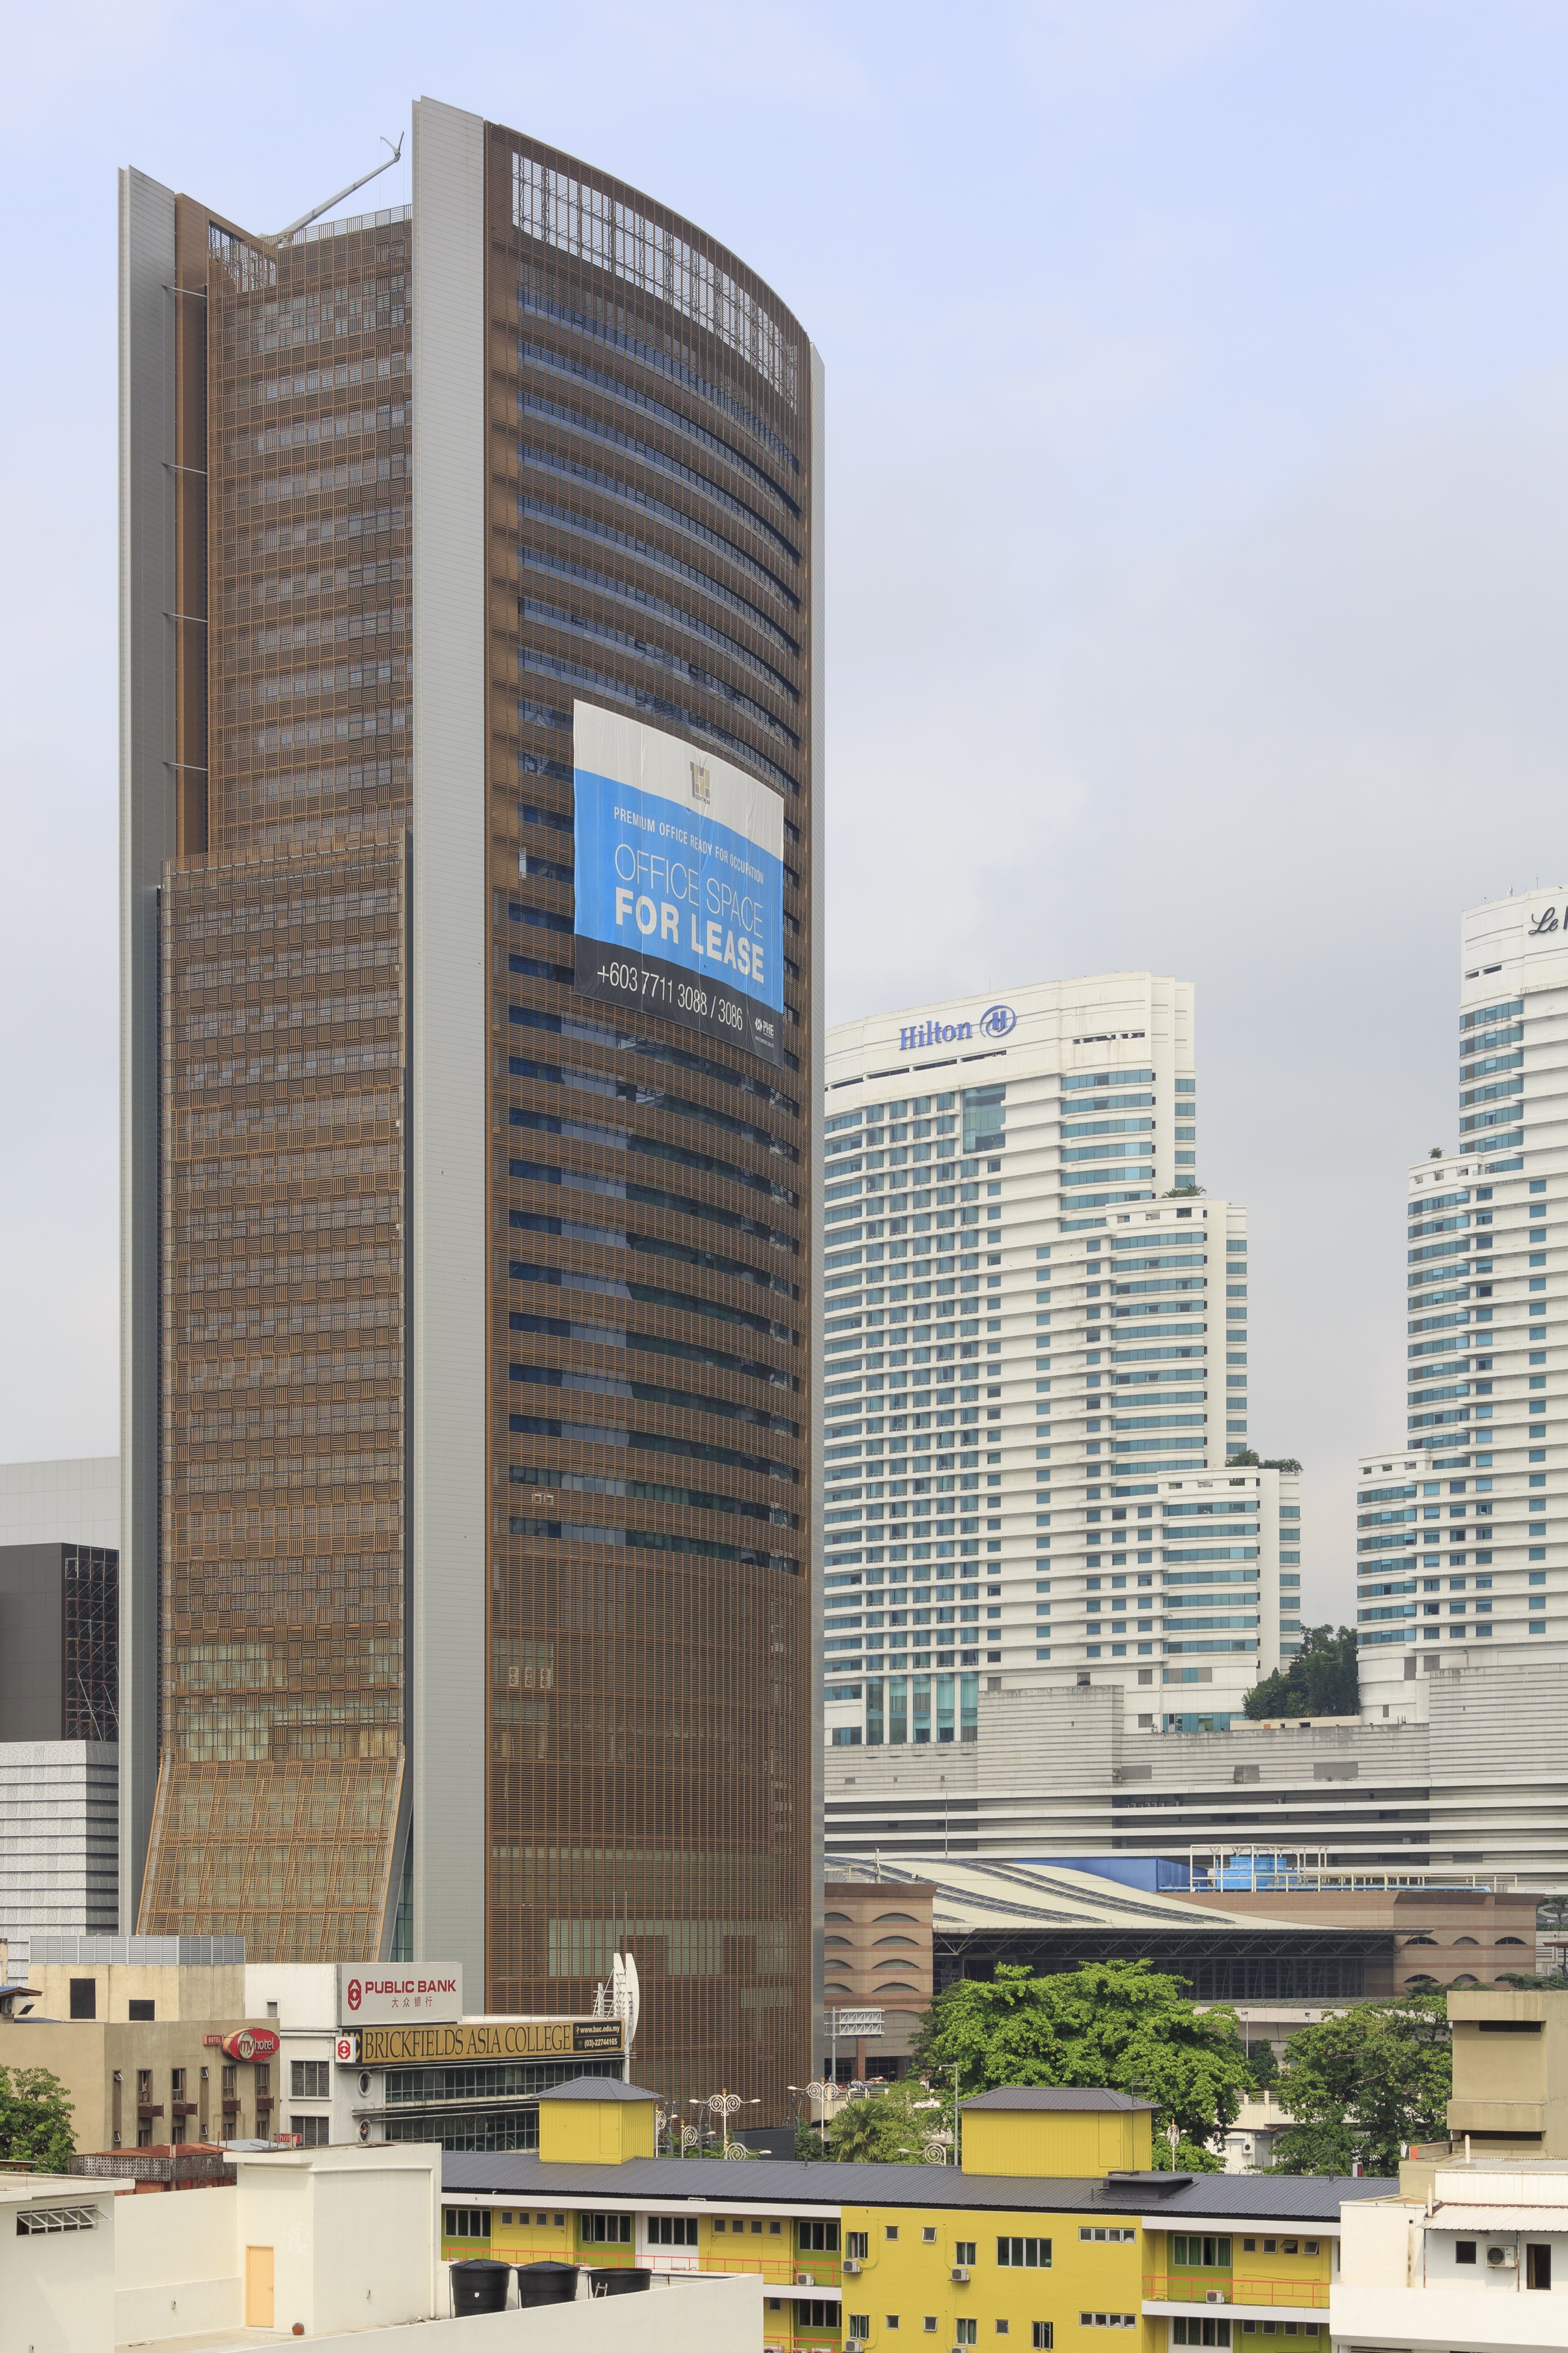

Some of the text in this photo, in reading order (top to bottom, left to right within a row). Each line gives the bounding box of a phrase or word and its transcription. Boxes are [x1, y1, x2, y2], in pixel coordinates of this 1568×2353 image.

[613, 806, 763, 885] PREMIUM OFFICE READY FOR OCCUPATION
[615, 844, 763, 939] OFFICE SPACE
[616, 886, 764, 984] FOR LEASE
[1528, 906, 1559, 935] Le
[597, 962, 638, 992] +603
[641, 970, 672, 1003] 7711
[678, 984, 707, 1016] 3088
[718, 998, 743, 1031] 3086
[763, 1020, 774, 1036] PHE
[899, 1020, 973, 1051] Hilton
[365, 1979, 456, 1994] PUBLIC BANK
[392, 1996, 432, 2008] 大众银行
[364, 2028, 463, 2059] BRICKFIELDS
[466, 2027, 502, 2054] ASIA
[505, 2024, 571, 2053] COLLEGE
[580, 2025, 620, 2034] www.bac.edu.my
[584, 2038, 618, 2048] (03)-22744165
